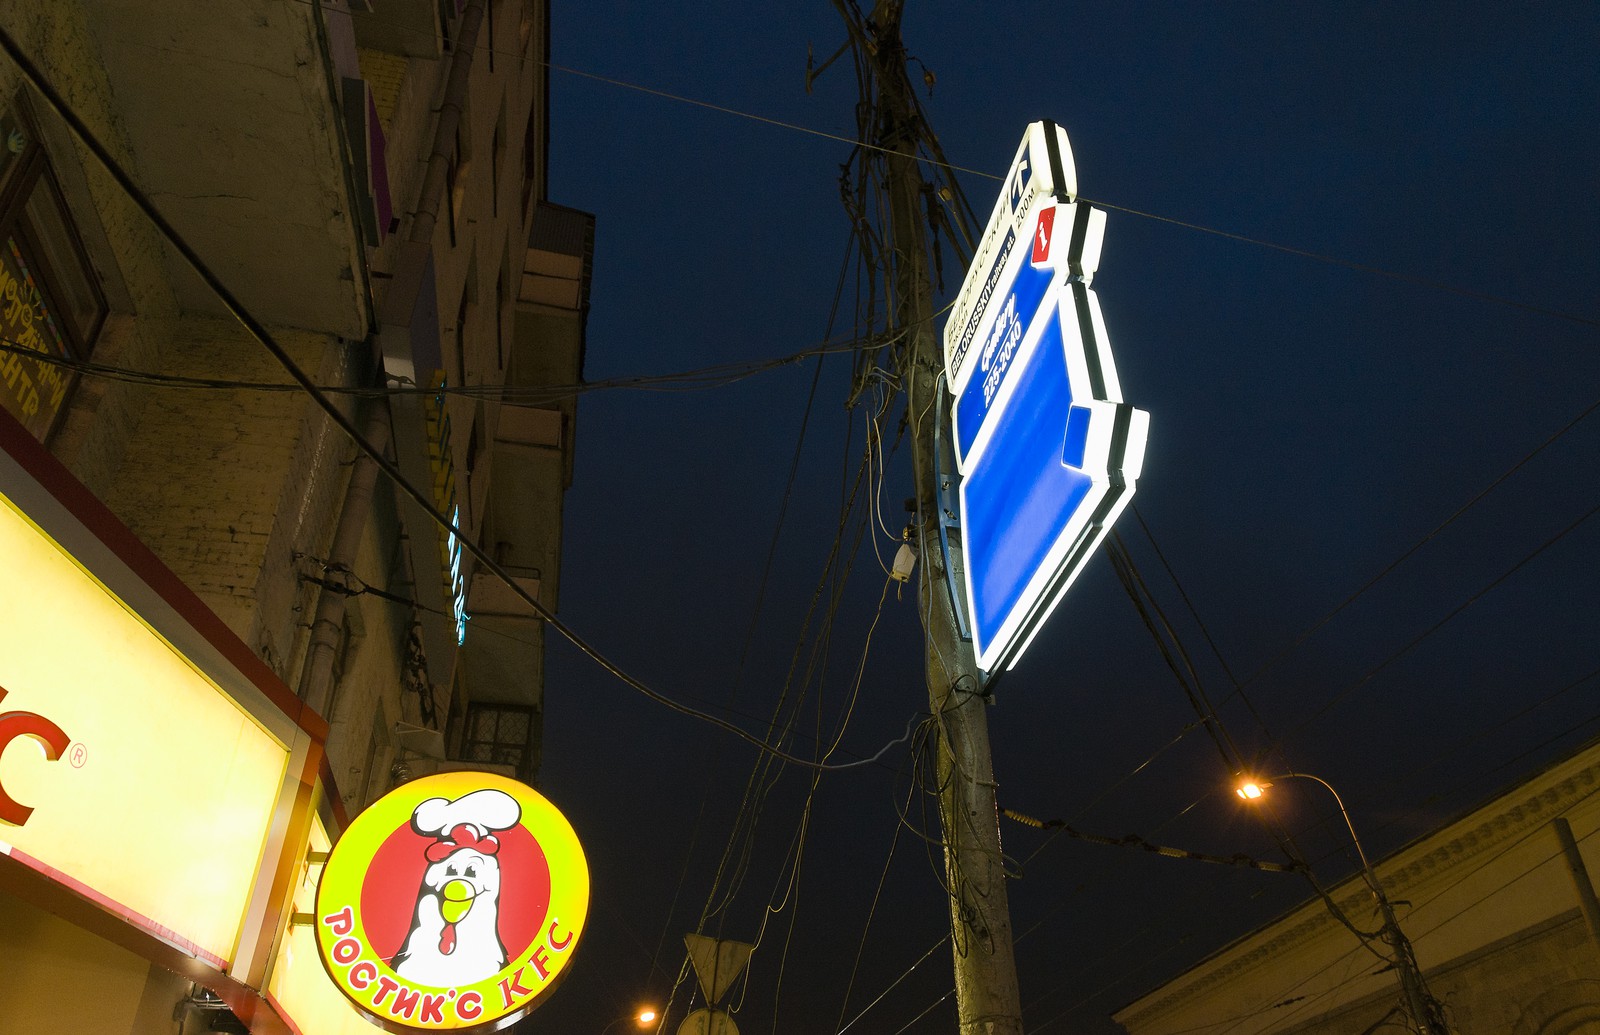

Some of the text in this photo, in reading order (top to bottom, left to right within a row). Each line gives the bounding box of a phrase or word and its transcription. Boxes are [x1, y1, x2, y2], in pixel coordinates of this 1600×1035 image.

[952, 235, 1015, 377] BELORUSSKIY railway st.
[982, 292, 1016, 372] Gallery
[984, 320, 1021, 408] 225-2040
[497, 920, 574, 1010] KFC
